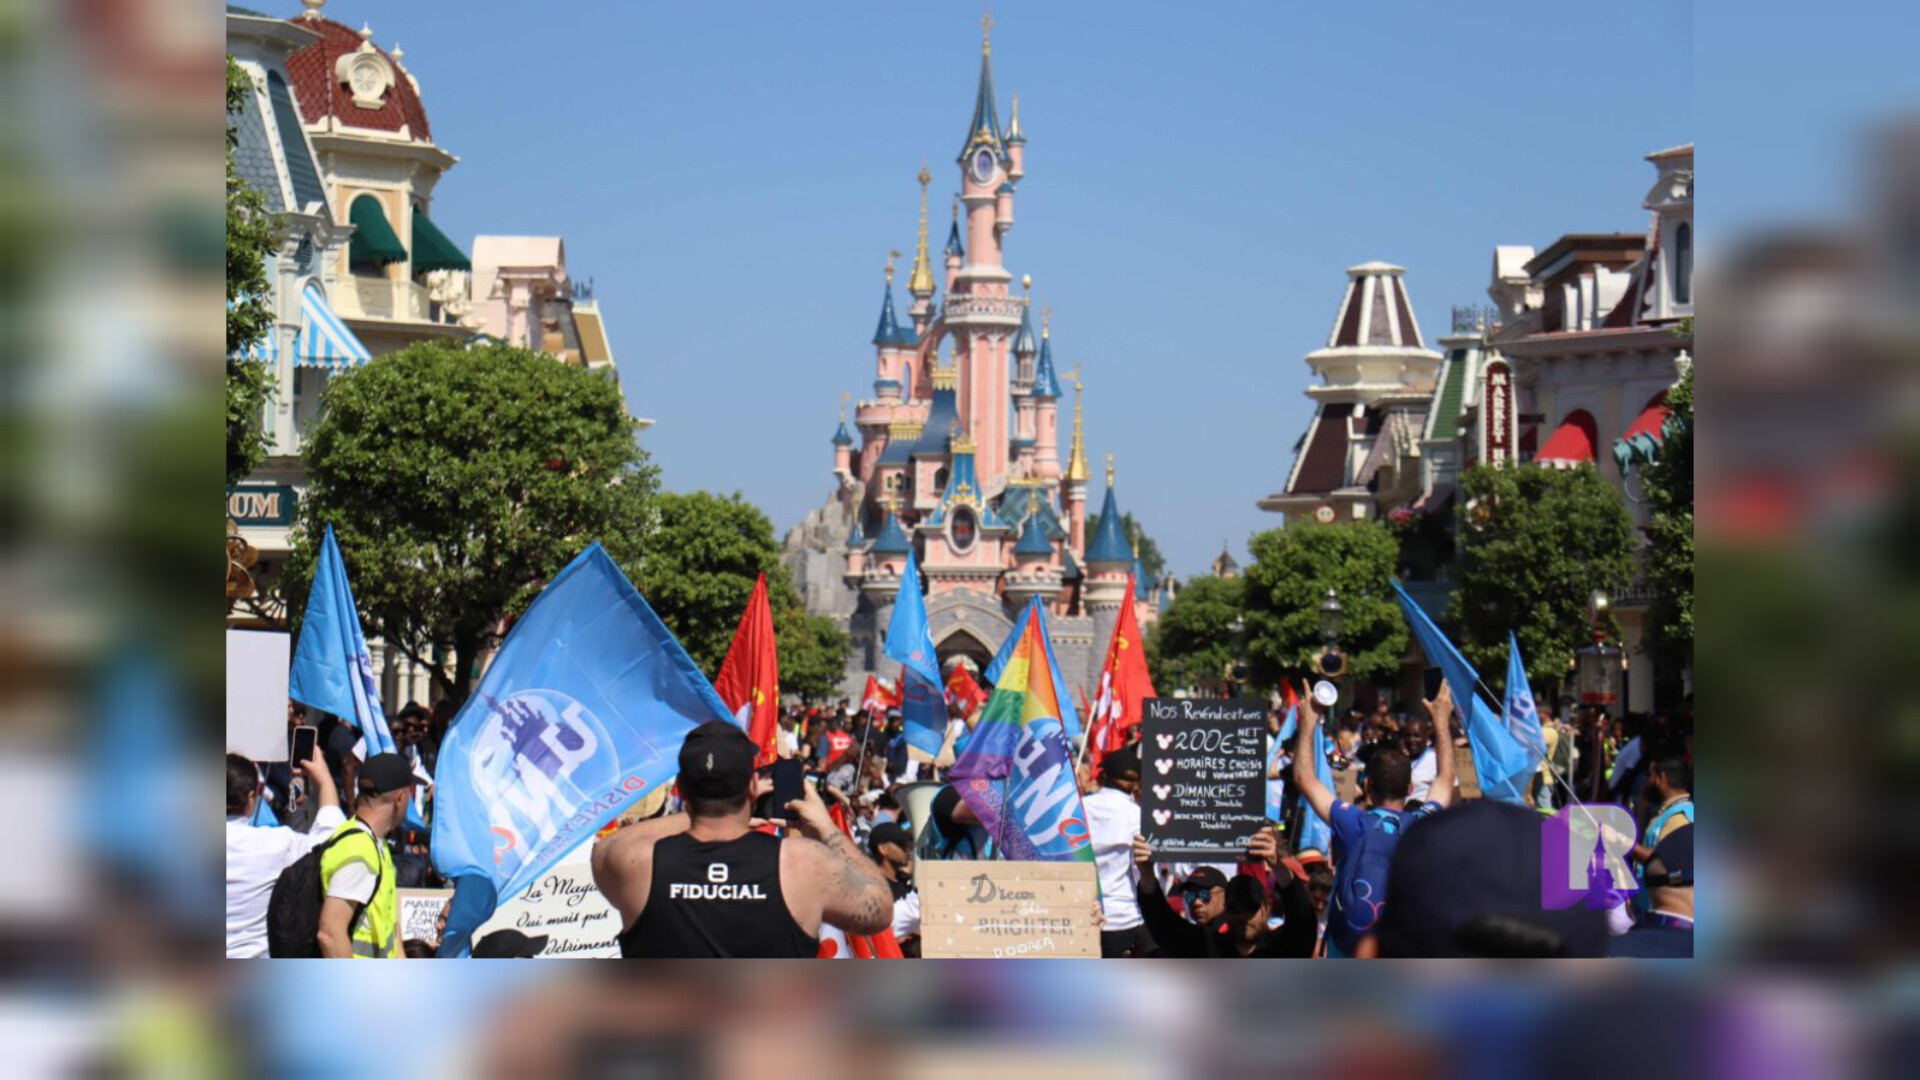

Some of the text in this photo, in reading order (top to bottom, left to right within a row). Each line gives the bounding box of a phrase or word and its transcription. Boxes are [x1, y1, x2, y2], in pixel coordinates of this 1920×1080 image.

[1491, 372, 1507, 443] MARKET
[226, 492, 281, 518] UM
[1174, 728, 1235, 754] 200€
[1237, 727, 1264, 738] NET
[669, 883, 767, 899] FIDUCIAL
[966, 873, 1036, 903] Dream
[516, 909, 610, 929] Oui mais pas
[978, 917, 1074, 936] BRIGHTER
